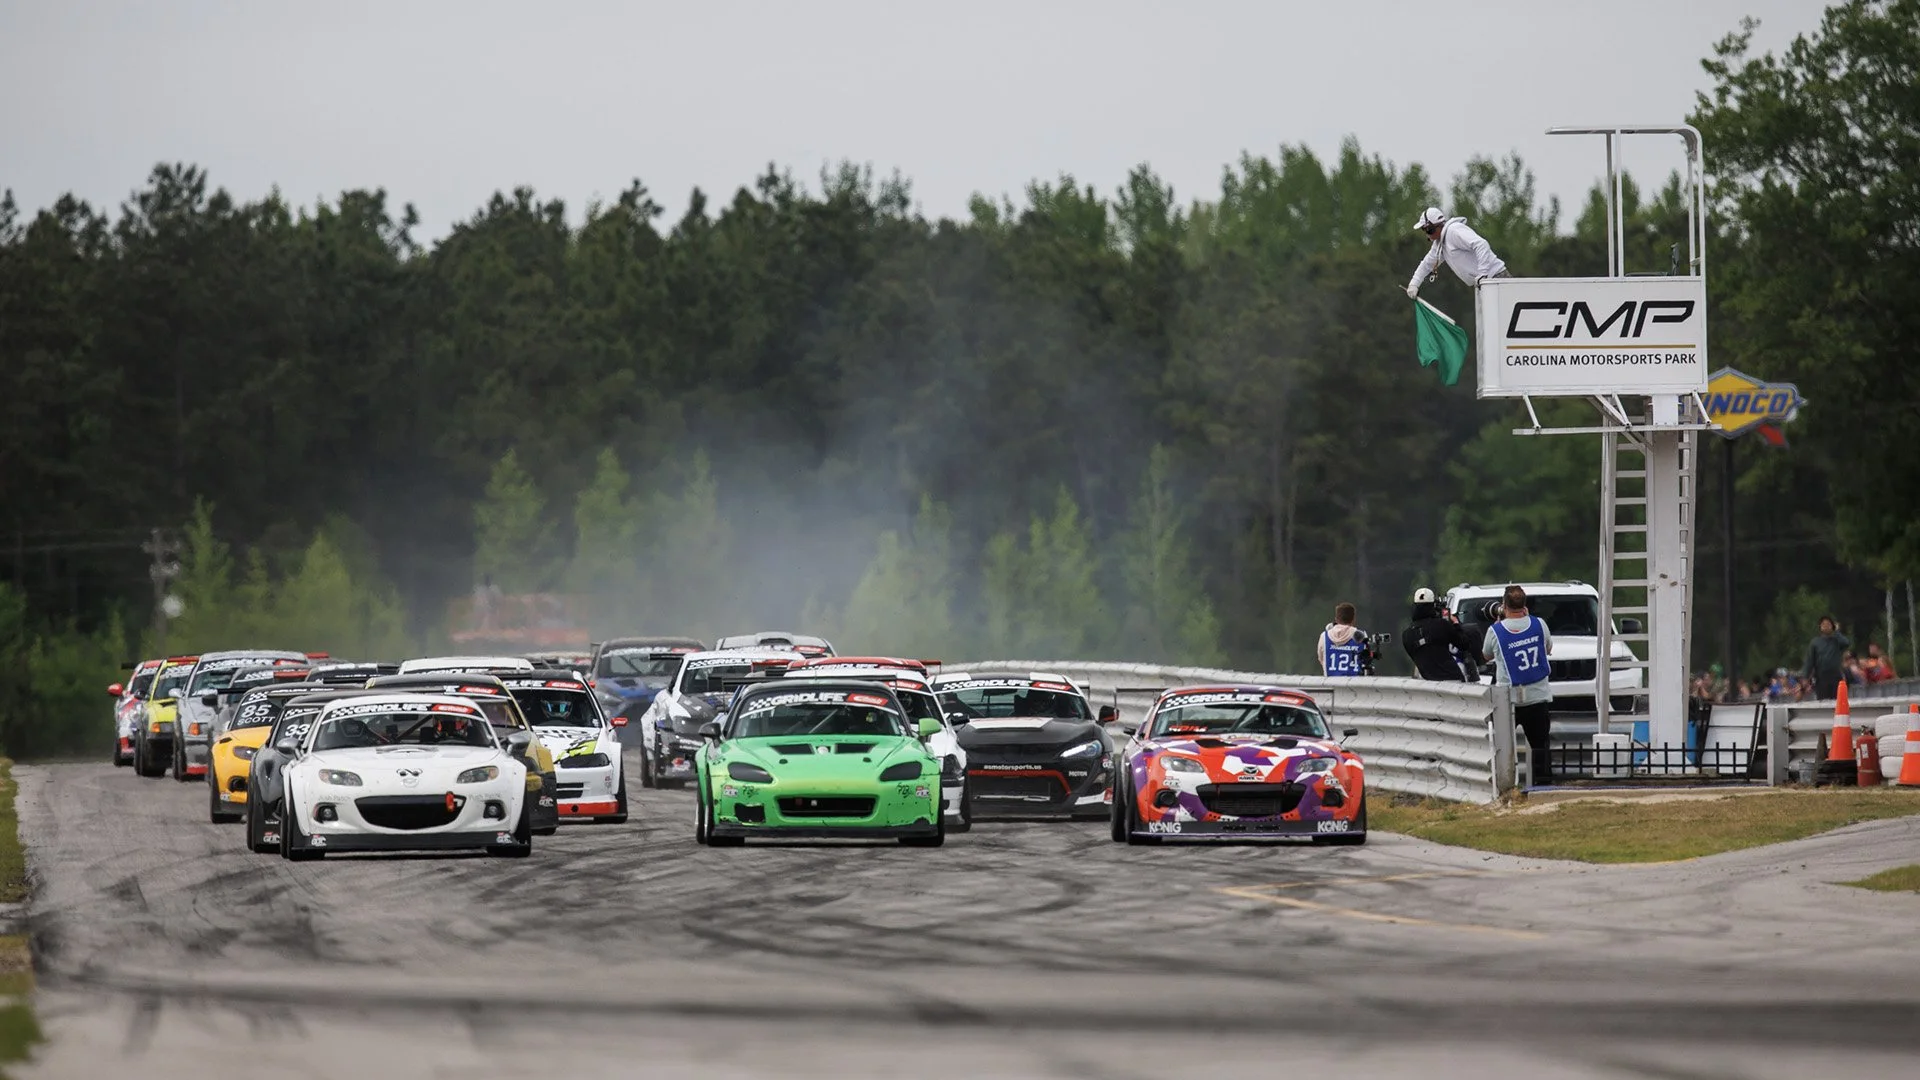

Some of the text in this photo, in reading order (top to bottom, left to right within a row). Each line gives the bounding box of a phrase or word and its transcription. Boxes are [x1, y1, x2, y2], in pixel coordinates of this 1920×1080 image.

[1506, 300, 1696, 338] CMP
[1506, 353, 1696, 366] CAROLINA MOTORSPORTS PARK
[1703, 392, 1789, 415] NOCO
[1328, 653, 1359, 672] 124
[1514, 646, 1539, 671] 37
[964, 679, 1033, 687] GRIDLIFE
[770, 692, 848, 706] GRIDLIFE
[1187, 694, 1264, 703] GRIDLIFE
[241, 704, 272, 718] 85
[353, 703, 432, 713] GRIDLIFE
[237, 716, 275, 726] SCOTT
[285, 724, 310, 737] 33
